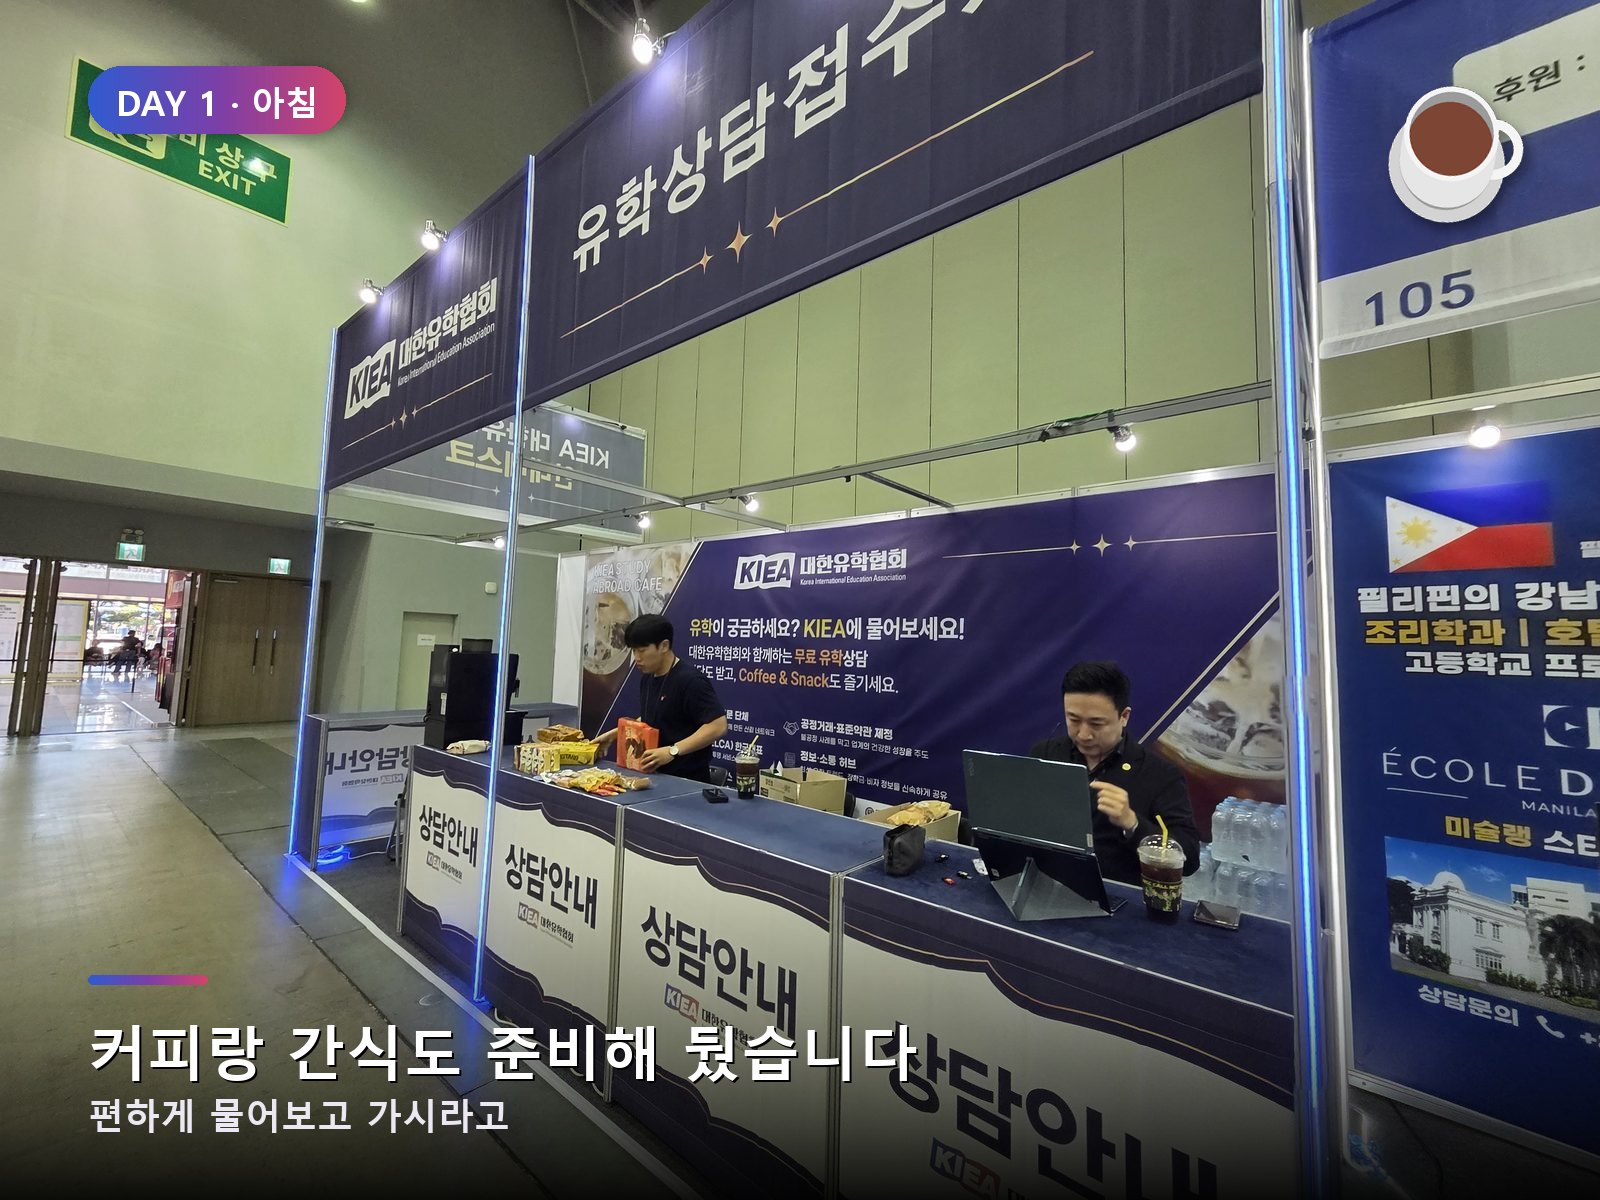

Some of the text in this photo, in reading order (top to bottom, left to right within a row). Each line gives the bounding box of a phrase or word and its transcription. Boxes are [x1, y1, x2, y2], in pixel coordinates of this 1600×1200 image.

[1493, 59, 1562, 102] 후원
[573, 0, 985, 273] 유학상담접수
[198, 159, 257, 196] EXIT
[1365, 269, 1475, 326] 105
[347, 277, 497, 409] KIEA 대한유학협회
[437, 342, 462, 363] Education
[462, 323, 495, 349] Association
[737, 548, 907, 586] KIEA 대한유학협회
[815, 577, 846, 585] International
[847, 575, 872, 583] Education
[873, 574, 906, 582] Association
[635, 577, 662, 592] CAFE
[1357, 584, 1500, 613] 필리핀의
[689, 617, 965, 641] 유학이 궁금하세요? KIEA에 물어보세요!
[1365, 619, 1507, 647] 조리학과
[689, 645, 868, 668] 대한유학협회와 함께하는 무료 유학상담
[1405, 651, 1532, 676] 고등학교
[716, 666, 736, 683] 받고,
[739, 668, 777, 685] Coffee
[779, 670, 788, 685] &
[791, 671, 841, 689] Snack도
[844, 674, 899, 694] 즐기세요.
[735, 711, 749, 721] 단체
[801, 718, 893, 740] 공정거래·표준약관 제정
[712, 739, 763, 755] LCA) 한국표
[800, 750, 856, 769] 정보·소통 허브
[871, 743, 891, 753] 건강한
[892, 746, 912, 757] 성장을
[914, 749, 929, 759] 주도
[1383, 746, 1542, 792] ÉCOLE
[902, 785, 930, 797] 신속하게
[933, 789, 947, 800] 공유
[1522, 800, 1598, 818] MANILA
[419, 805, 478, 868] 상담안내
[505, 844, 598, 930] 상담안내
[641, 905, 797, 1041] 상담안내
[664, 983, 699, 1024] KIEA
[1418, 983, 1520, 1027] 상담문의
